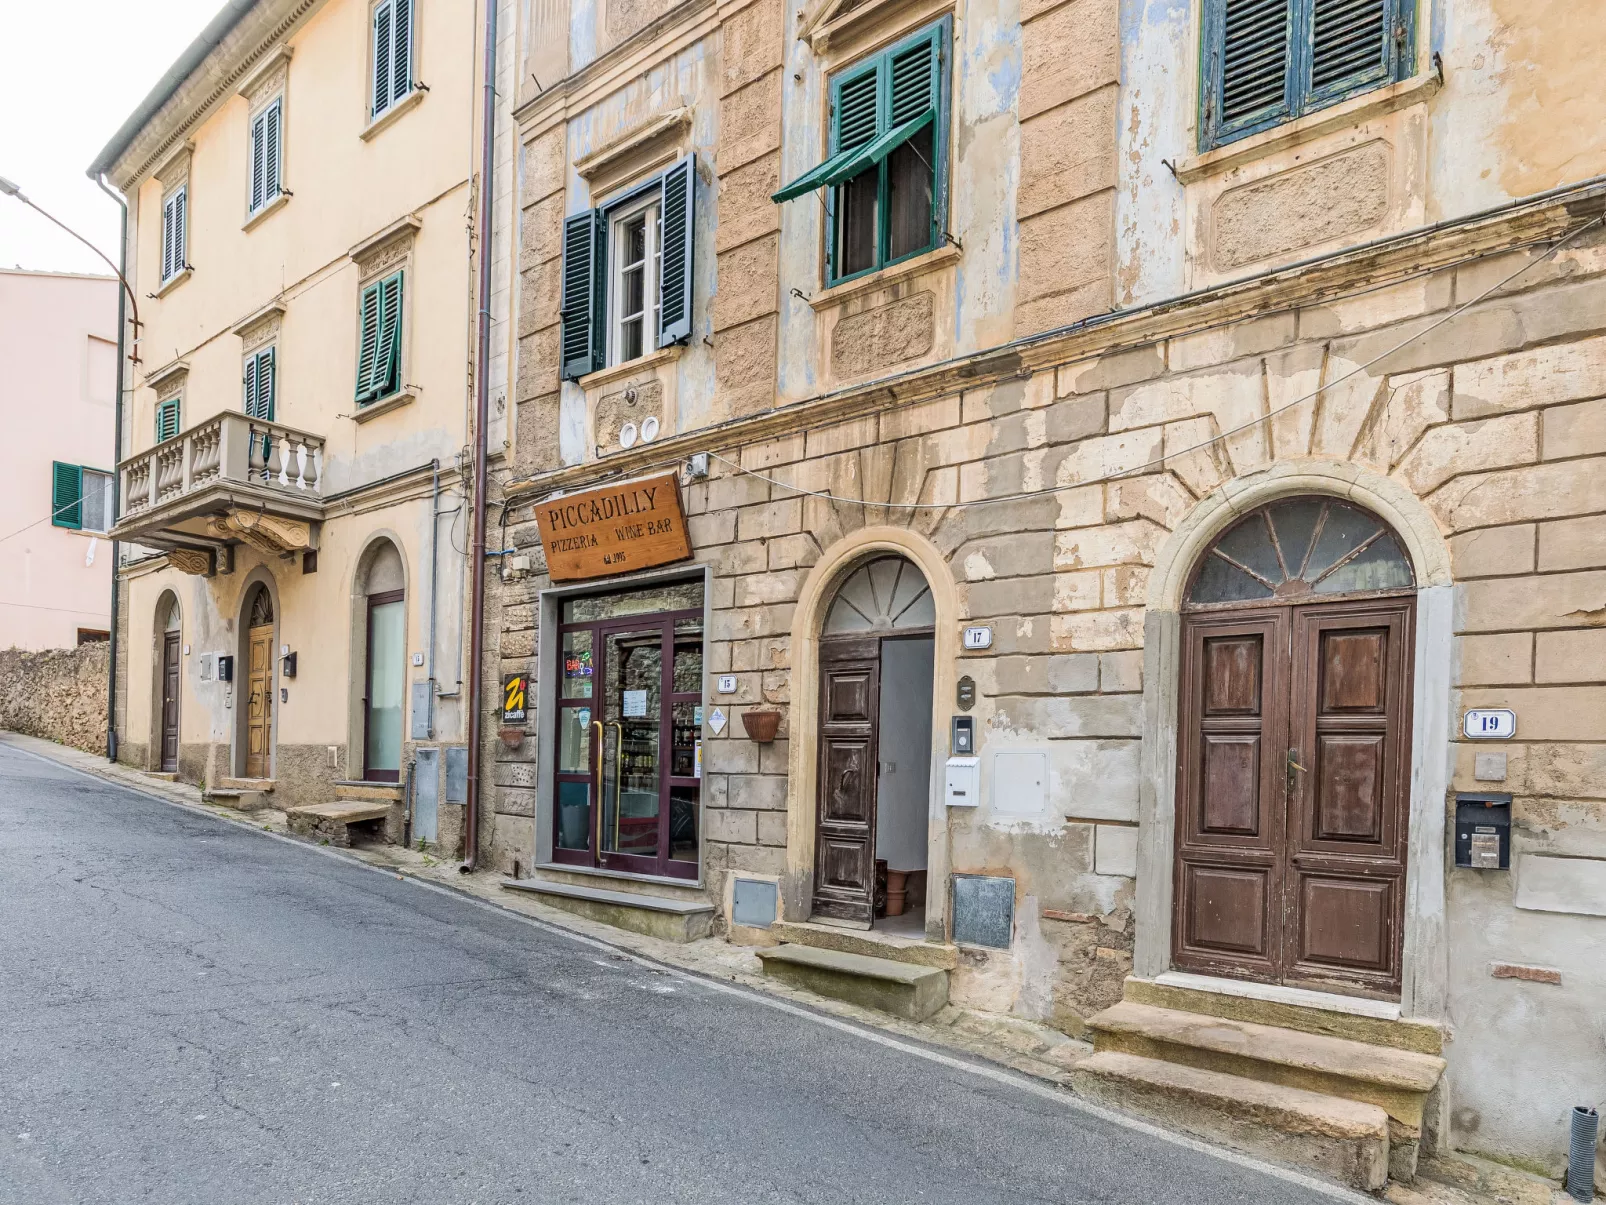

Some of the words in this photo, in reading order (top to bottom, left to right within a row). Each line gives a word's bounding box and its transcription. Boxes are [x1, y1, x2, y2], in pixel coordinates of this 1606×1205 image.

[548, 487, 657, 531] PICCADILLY
[551, 534, 598, 553] PIZZERIA
[614, 523, 645, 541] WINE
[648, 518, 673, 535] BAR
[973, 632, 982, 643] 17
[1482, 716, 1499, 731] 19
